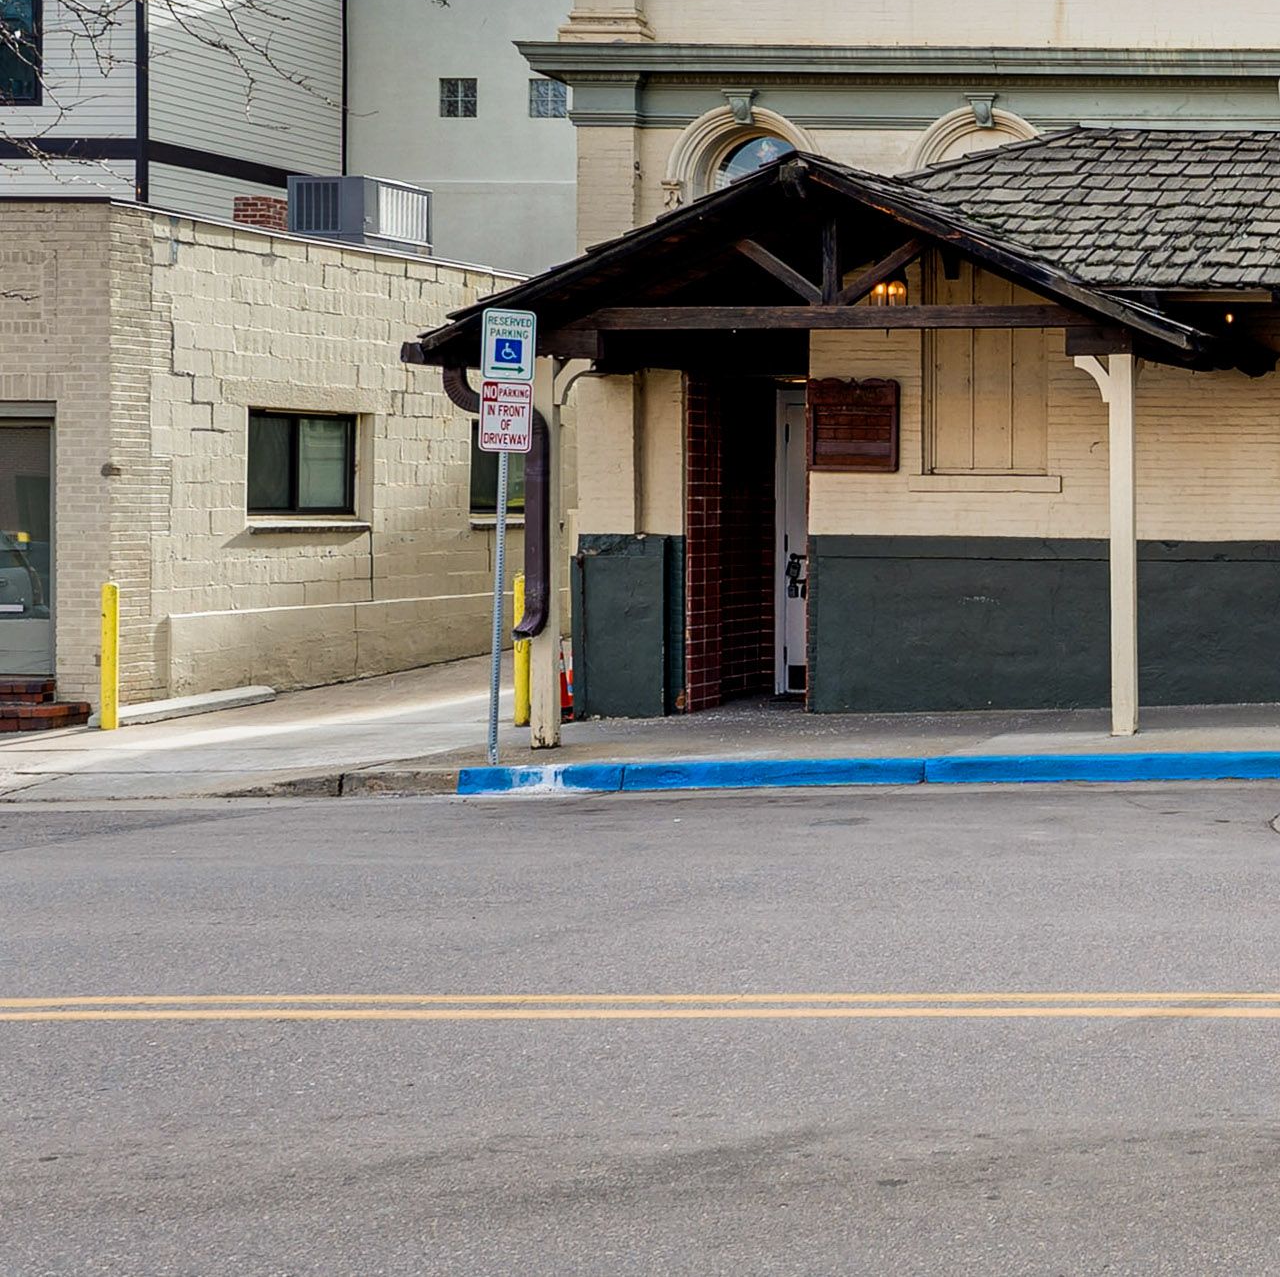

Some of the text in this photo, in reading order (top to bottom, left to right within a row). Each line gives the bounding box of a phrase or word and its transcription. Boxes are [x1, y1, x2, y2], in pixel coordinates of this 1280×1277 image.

[488, 316, 532, 328] RESERVED
[490, 327, 529, 339] PARKING
[484, 385, 529, 399] NO PARKING
[487, 404, 526, 418] IN FRONT
[501, 419, 512, 431] OF
[484, 432, 528, 445] DRIVEWAY
